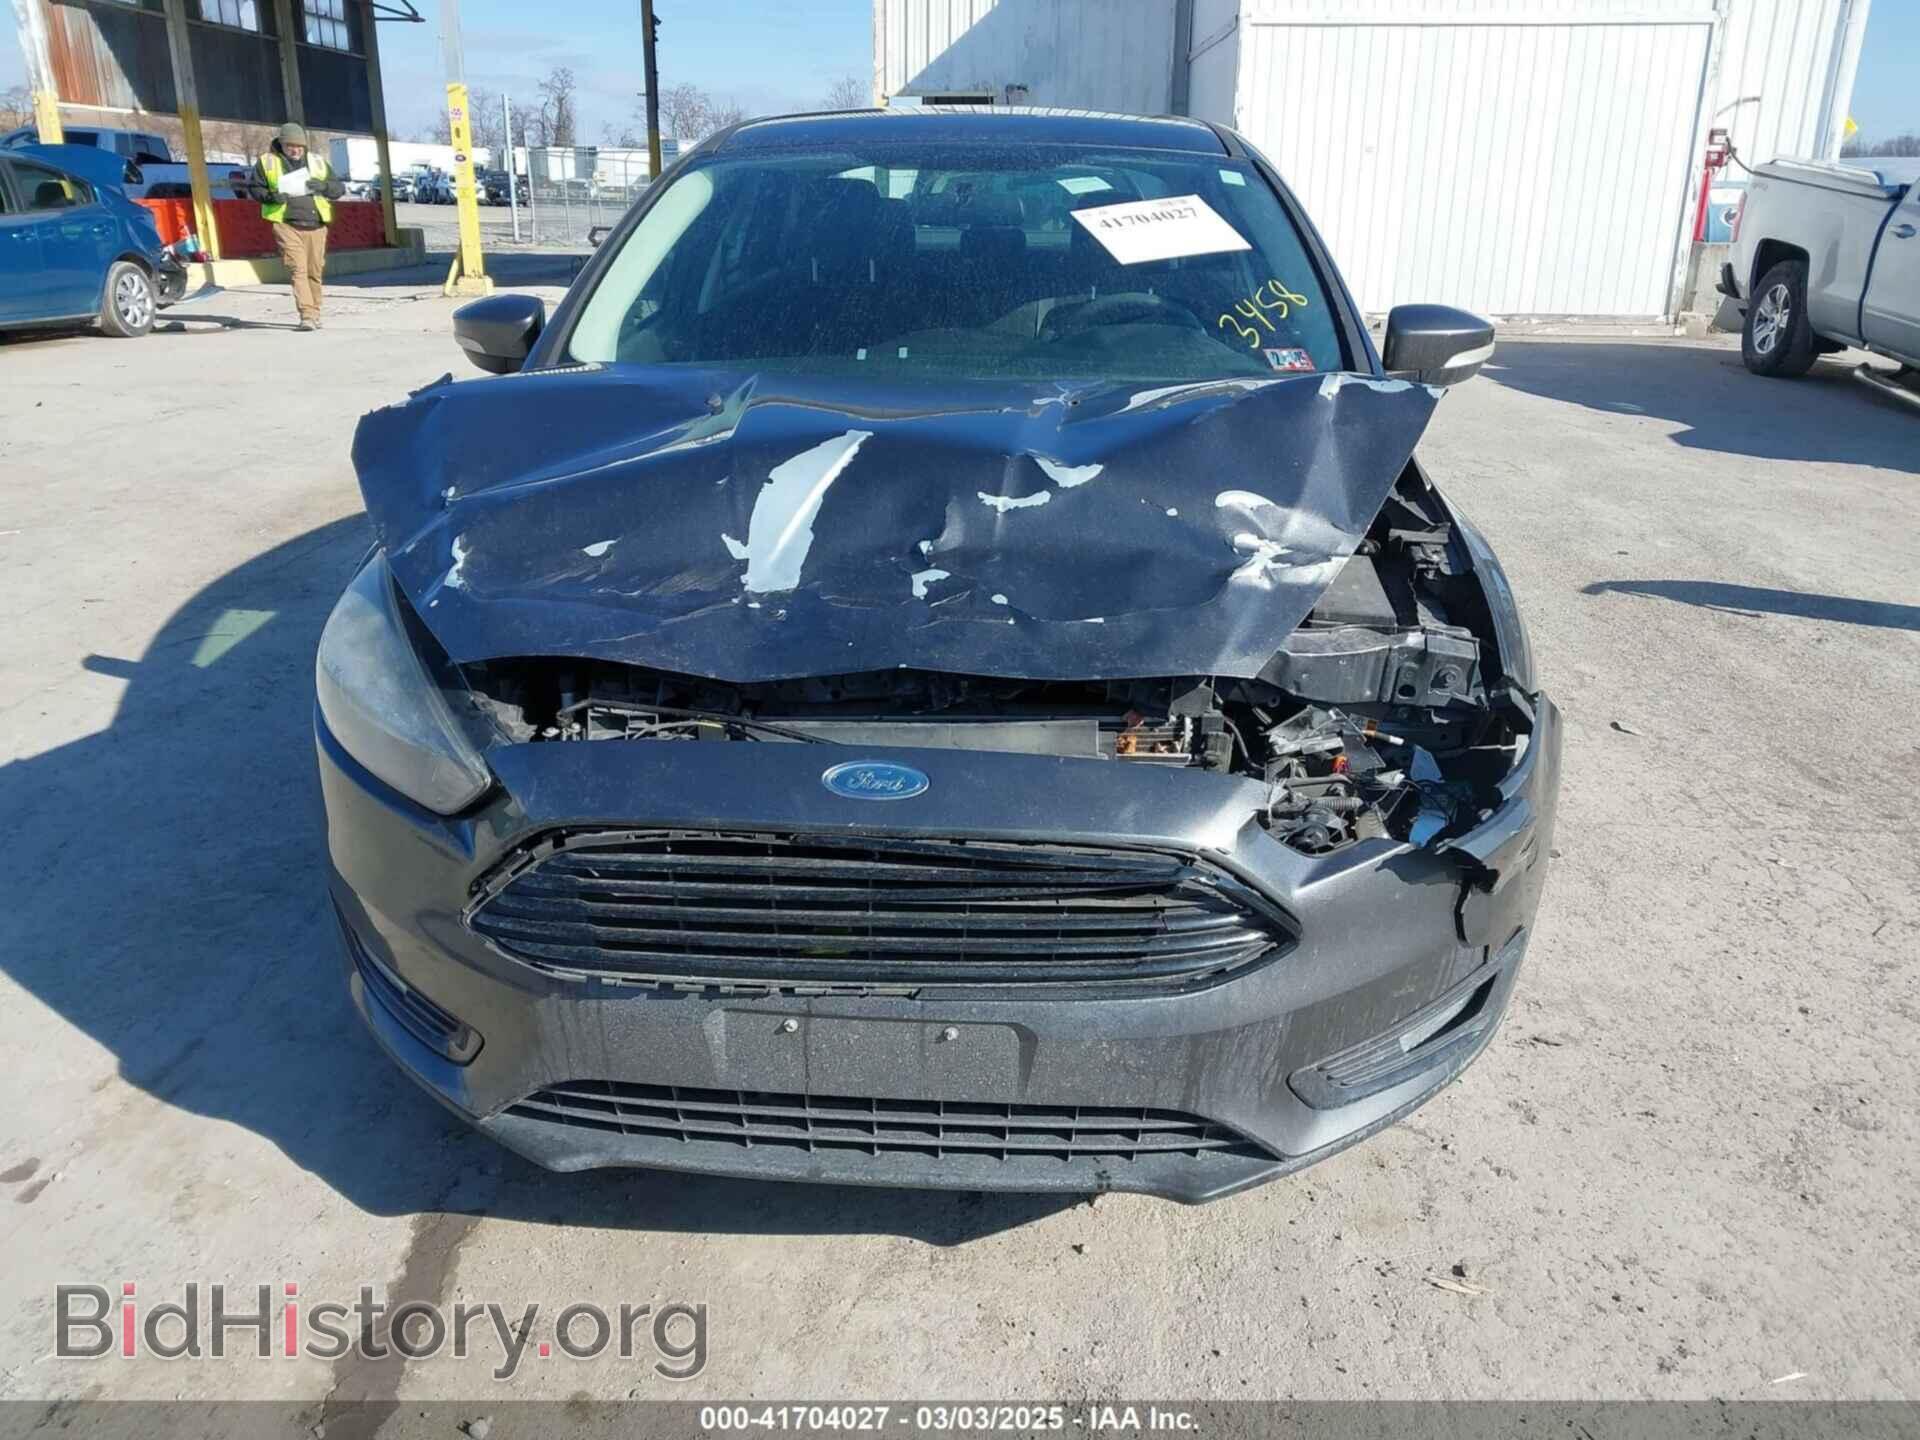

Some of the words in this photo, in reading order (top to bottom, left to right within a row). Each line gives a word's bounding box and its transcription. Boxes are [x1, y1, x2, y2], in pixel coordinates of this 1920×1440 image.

[1099, 207, 1199, 229] 41704027
[1219, 279, 1308, 349] 3458
[846, 769, 906, 791] Ford
